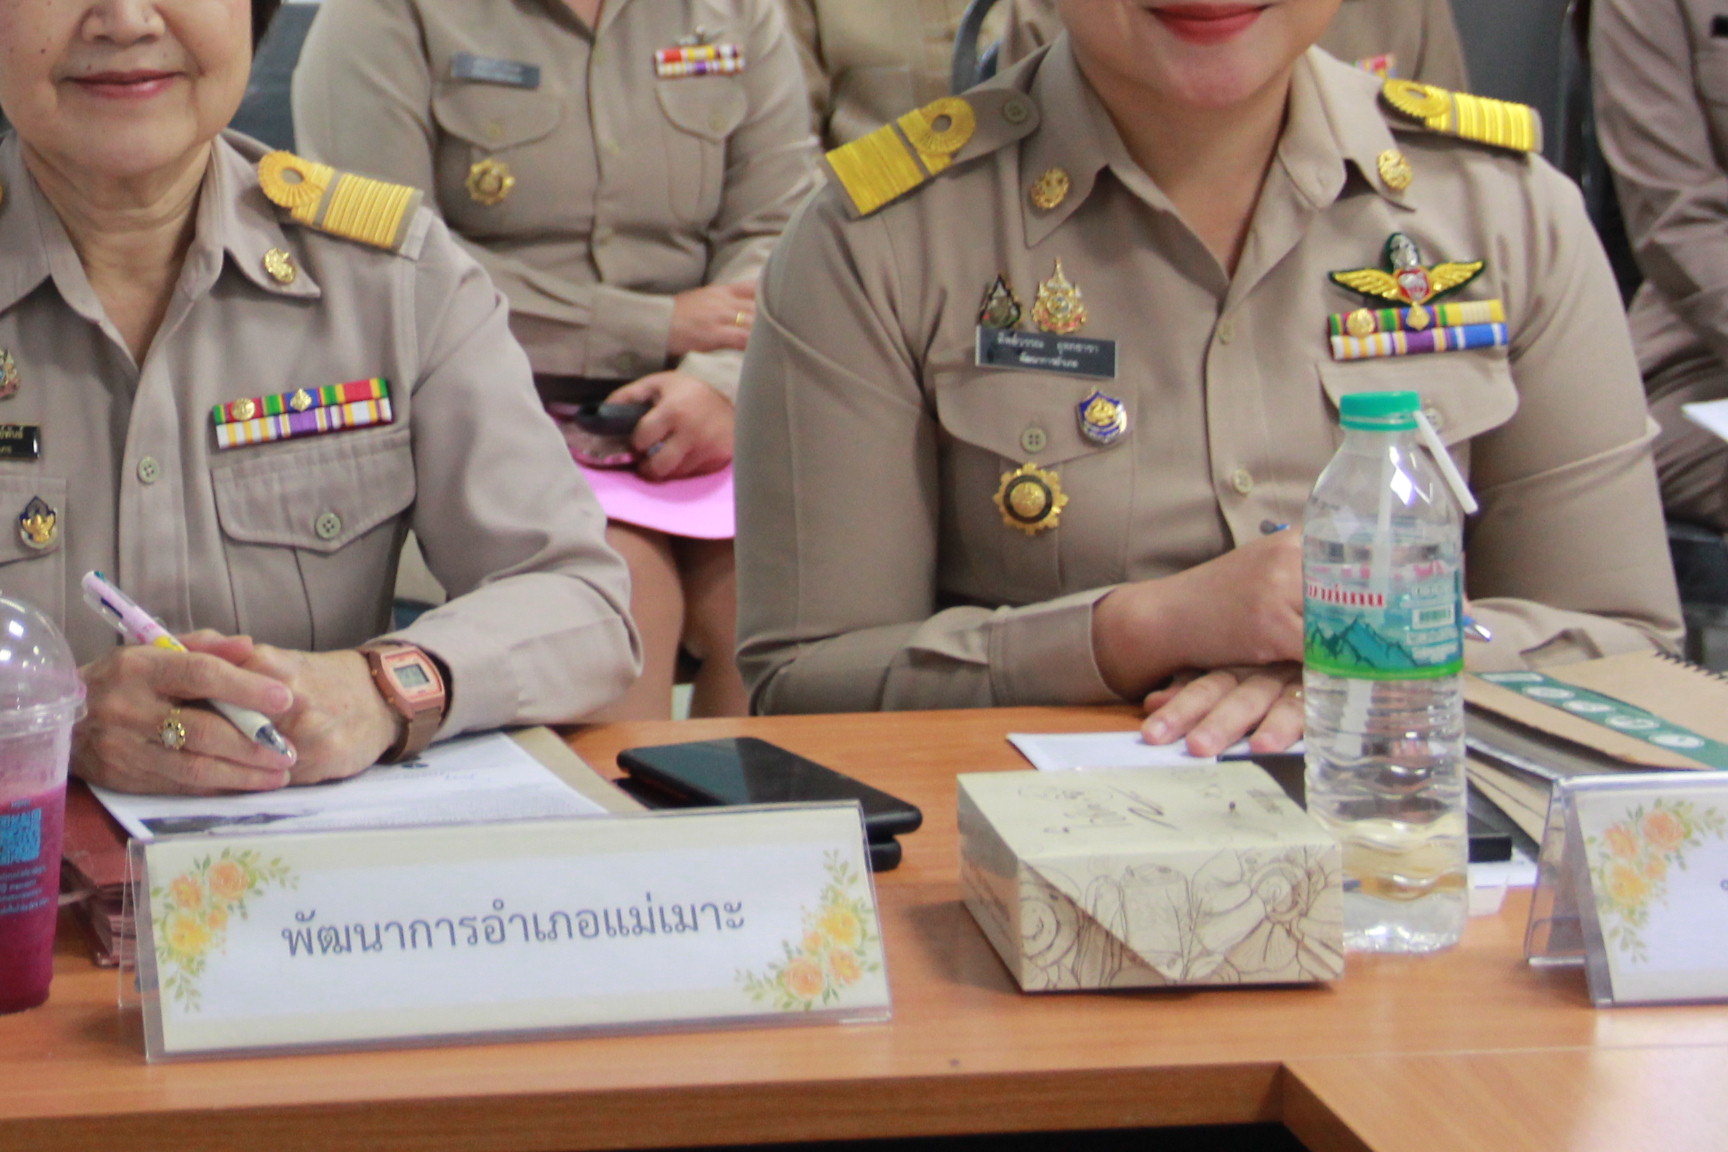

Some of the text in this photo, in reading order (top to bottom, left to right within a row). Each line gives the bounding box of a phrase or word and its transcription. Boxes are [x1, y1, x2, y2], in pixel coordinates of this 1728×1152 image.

[281, 892, 745, 958] พัฒนาการอำเภอแม่เมาะ
